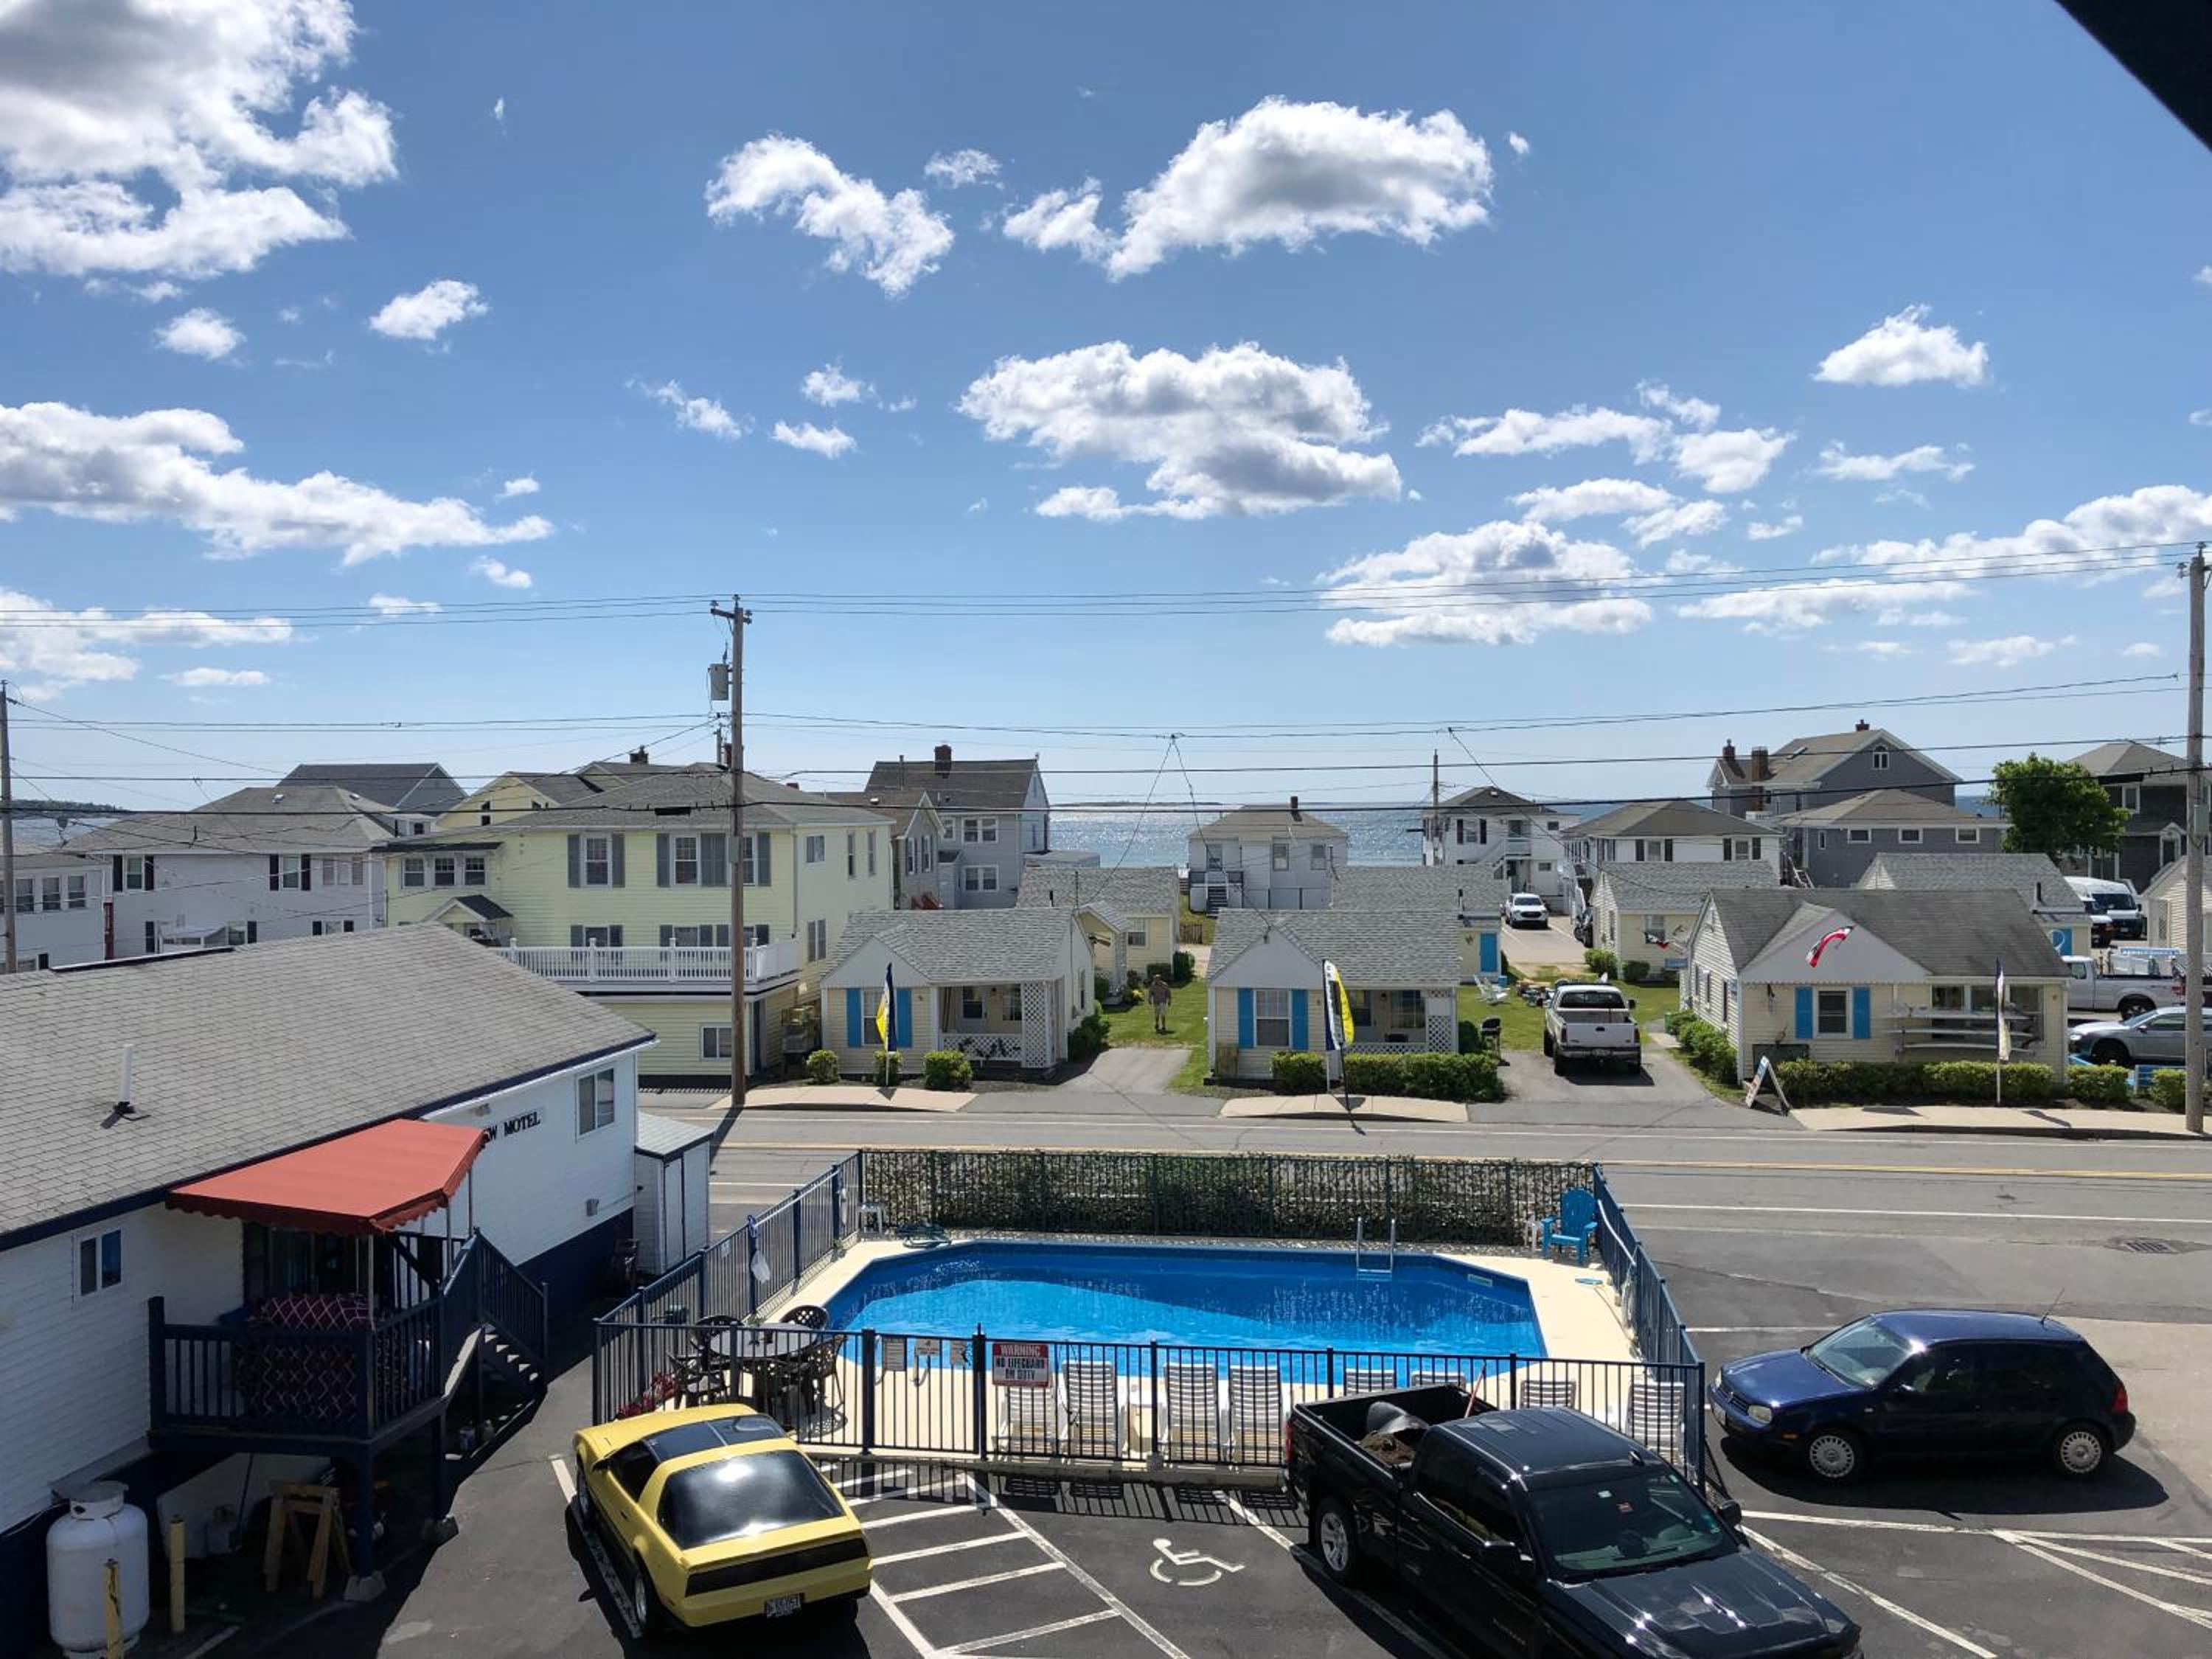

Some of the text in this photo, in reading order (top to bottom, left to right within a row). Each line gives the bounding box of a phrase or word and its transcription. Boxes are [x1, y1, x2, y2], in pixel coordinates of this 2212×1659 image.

[504, 1111, 540, 1137] MOTEL
[1001, 1344, 1041, 1356] WARNING
[997, 1357, 1045, 1369] NO LIFEGUARD
[1018, 1369, 1035, 1381] DUTY
